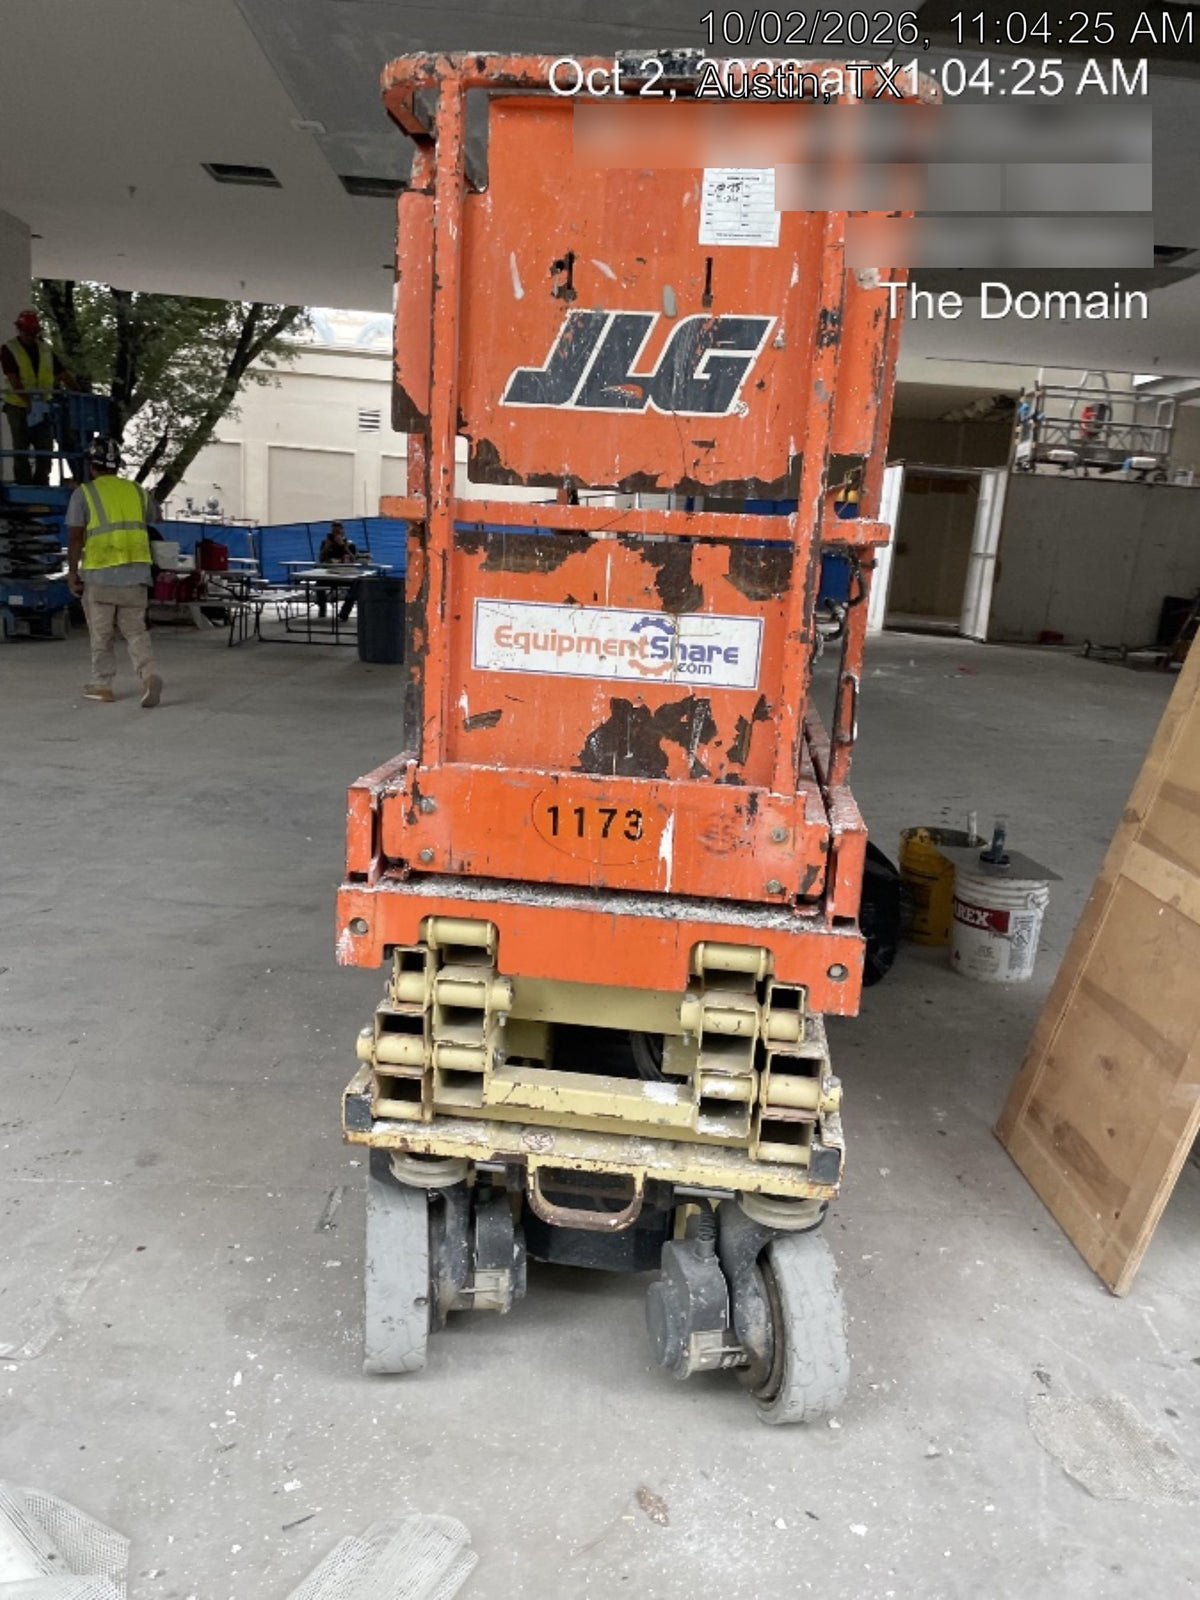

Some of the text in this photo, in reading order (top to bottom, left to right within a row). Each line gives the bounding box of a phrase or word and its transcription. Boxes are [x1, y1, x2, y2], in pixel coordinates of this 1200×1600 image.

[498, 308, 778, 417] JLG
[494, 624, 739, 665] EquipmentShare
[546, 805, 644, 842] 1173
